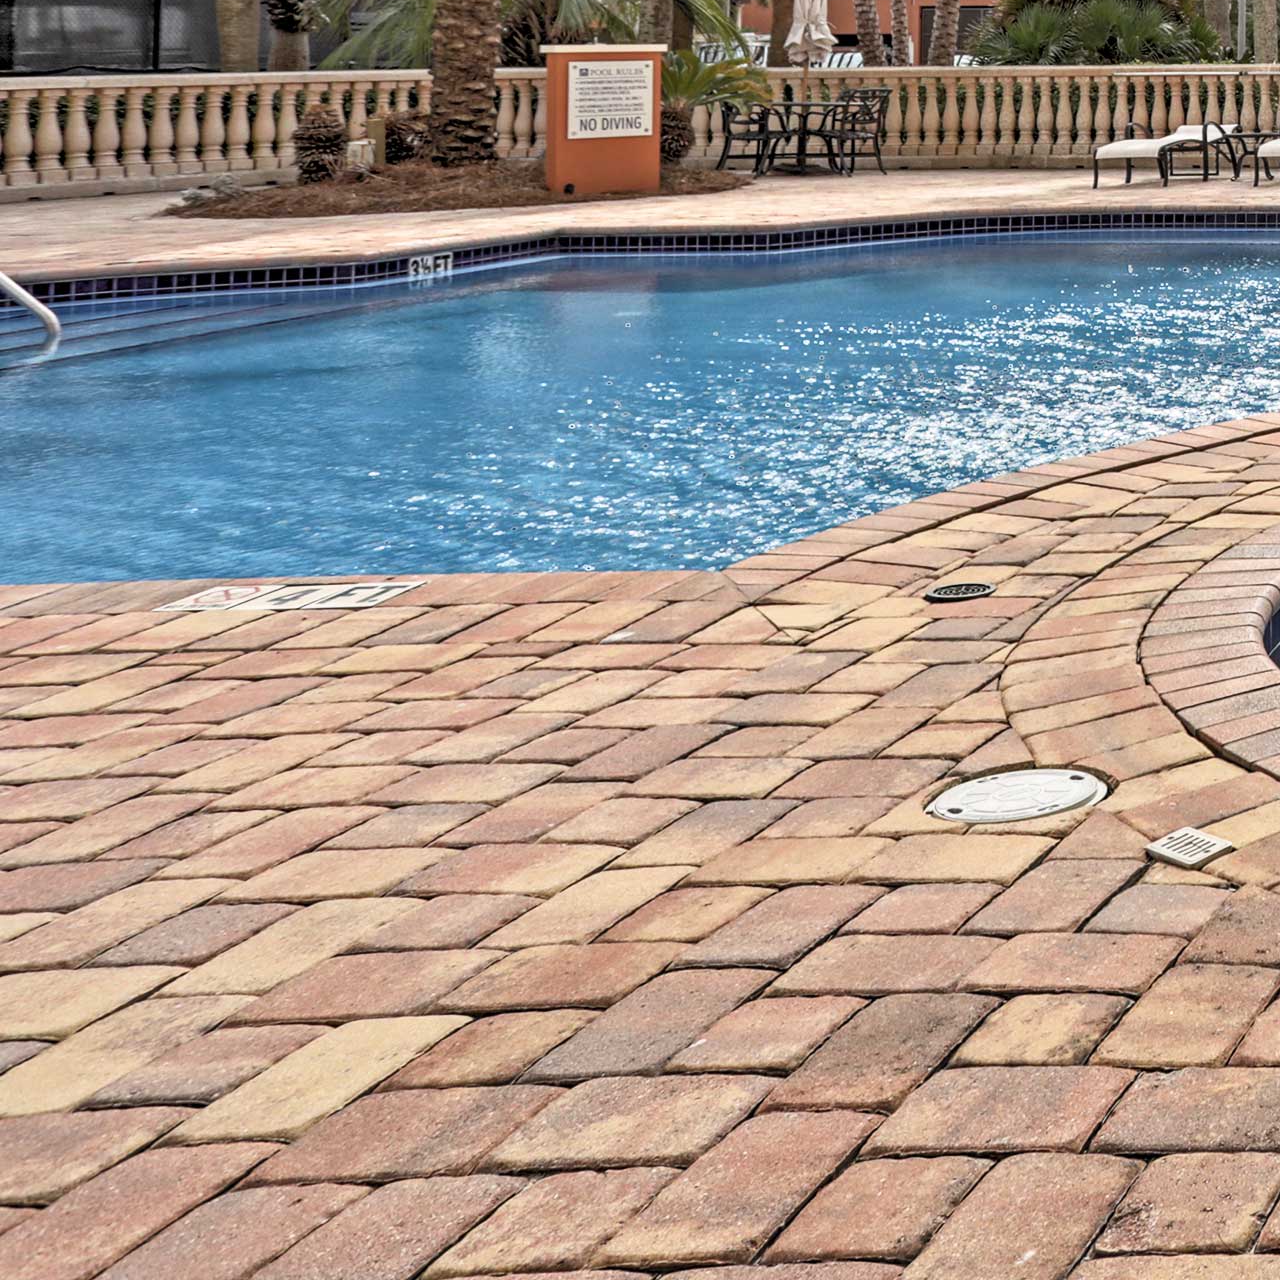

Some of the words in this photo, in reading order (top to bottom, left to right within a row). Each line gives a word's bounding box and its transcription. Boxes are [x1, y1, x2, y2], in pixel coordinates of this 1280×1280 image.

[590, 68, 612, 76] POOL
[616, 67, 643, 75] RULES
[580, 118, 597, 132] NO
[601, 116, 642, 131] DIVING
[433, 254, 451, 273] FT
[266, 588, 320, 605] 4
